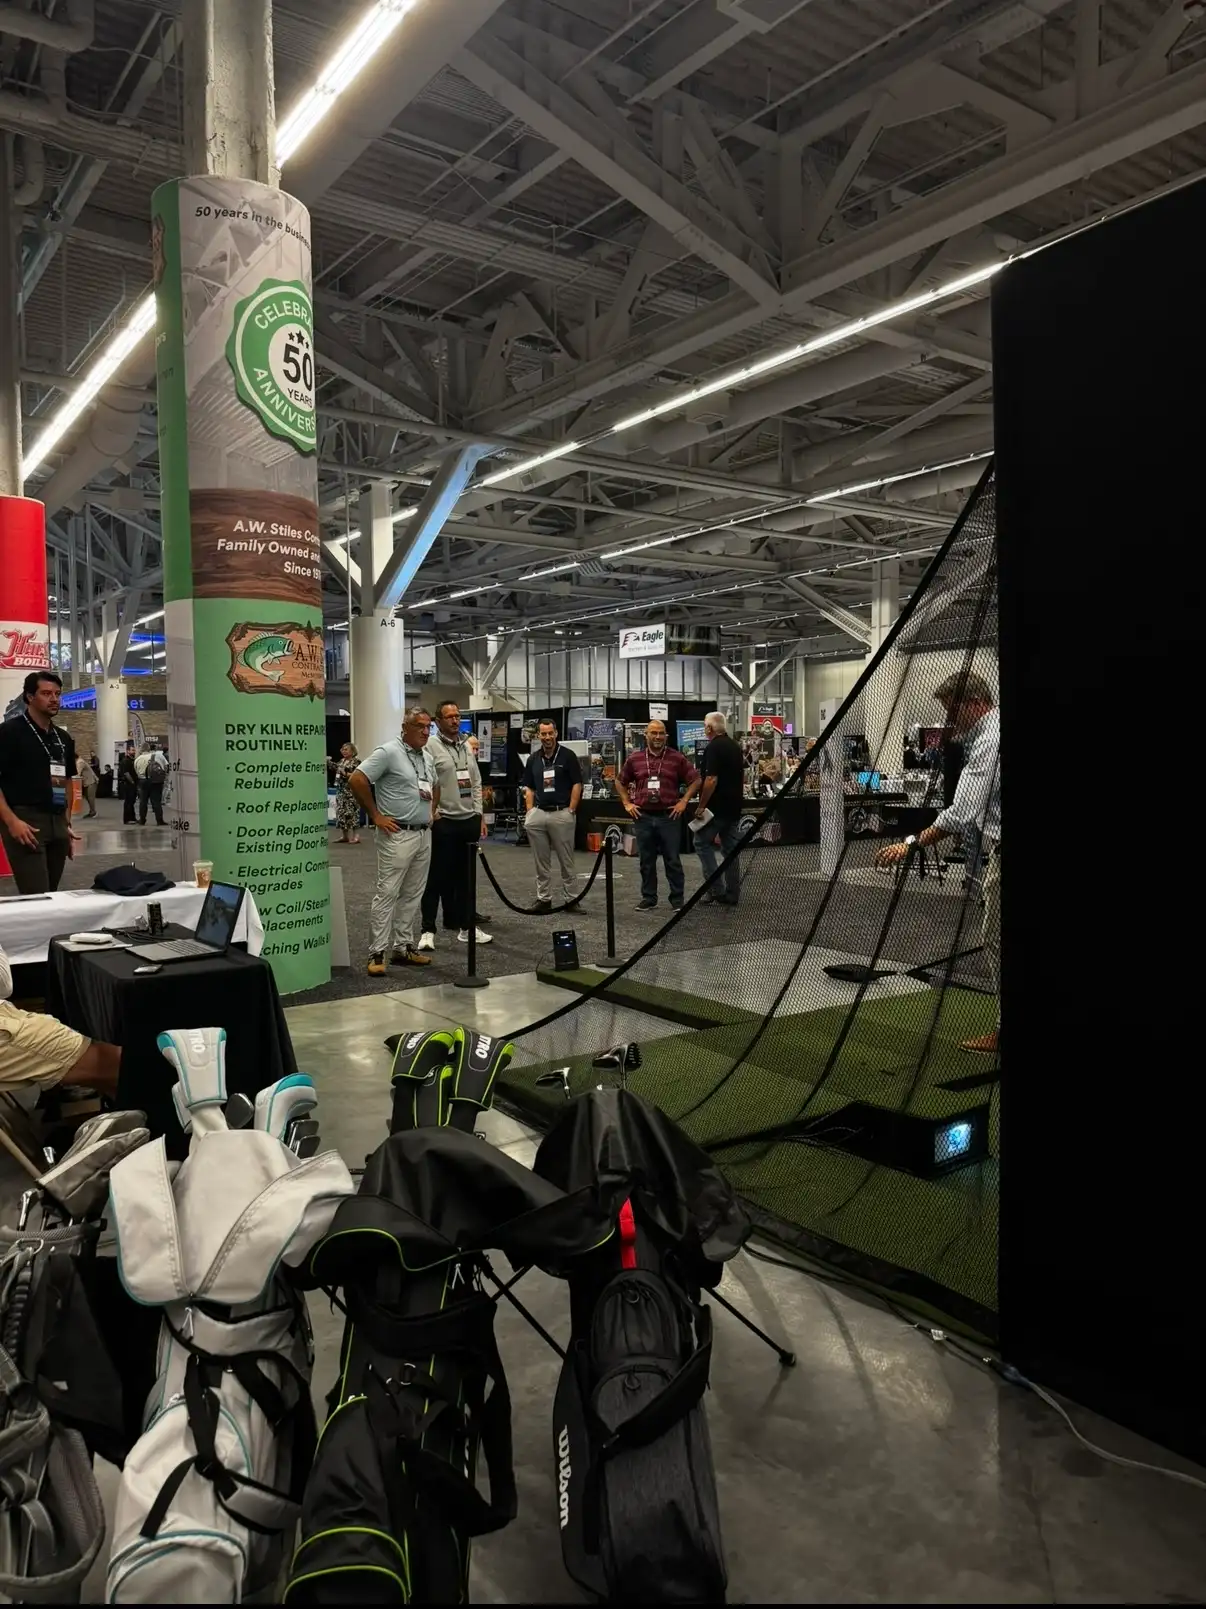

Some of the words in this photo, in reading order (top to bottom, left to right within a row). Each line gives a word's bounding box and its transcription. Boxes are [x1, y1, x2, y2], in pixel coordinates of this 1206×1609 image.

[195, 206, 211, 217] 50
[214, 208, 248, 220] years
[252, 211, 262, 223] in
[265, 215, 283, 229] the
[283, 343, 313, 392] 50
[233, 519, 267, 533] A.W.
[270, 522, 303, 539] Stiles
[217, 538, 266, 554] Family
[268, 541, 309, 559] Owned
[283, 561, 312, 577] Since
[380, 618, 396, 628] A-6
[641, 629, 664, 644] Eagle
[224, 723, 256, 736] DRY
[260, 723, 293, 736] KILN
[225, 739, 308, 752] ROUTINELY:
[234, 761, 303, 776] Complete
[234, 777, 295, 790] Rebuilds
[235, 801, 271, 814] Roof
[236, 825, 273, 838] Door
[235, 841, 292, 854] Existing
[295, 838, 319, 851] Door
[237, 862, 303, 878] Electrical
[238, 879, 304, 896] pgrades
[262, 914, 324, 933] lacements
[259, 939, 300, 956] ching
[558, 1424, 572, 1530] Wilson
